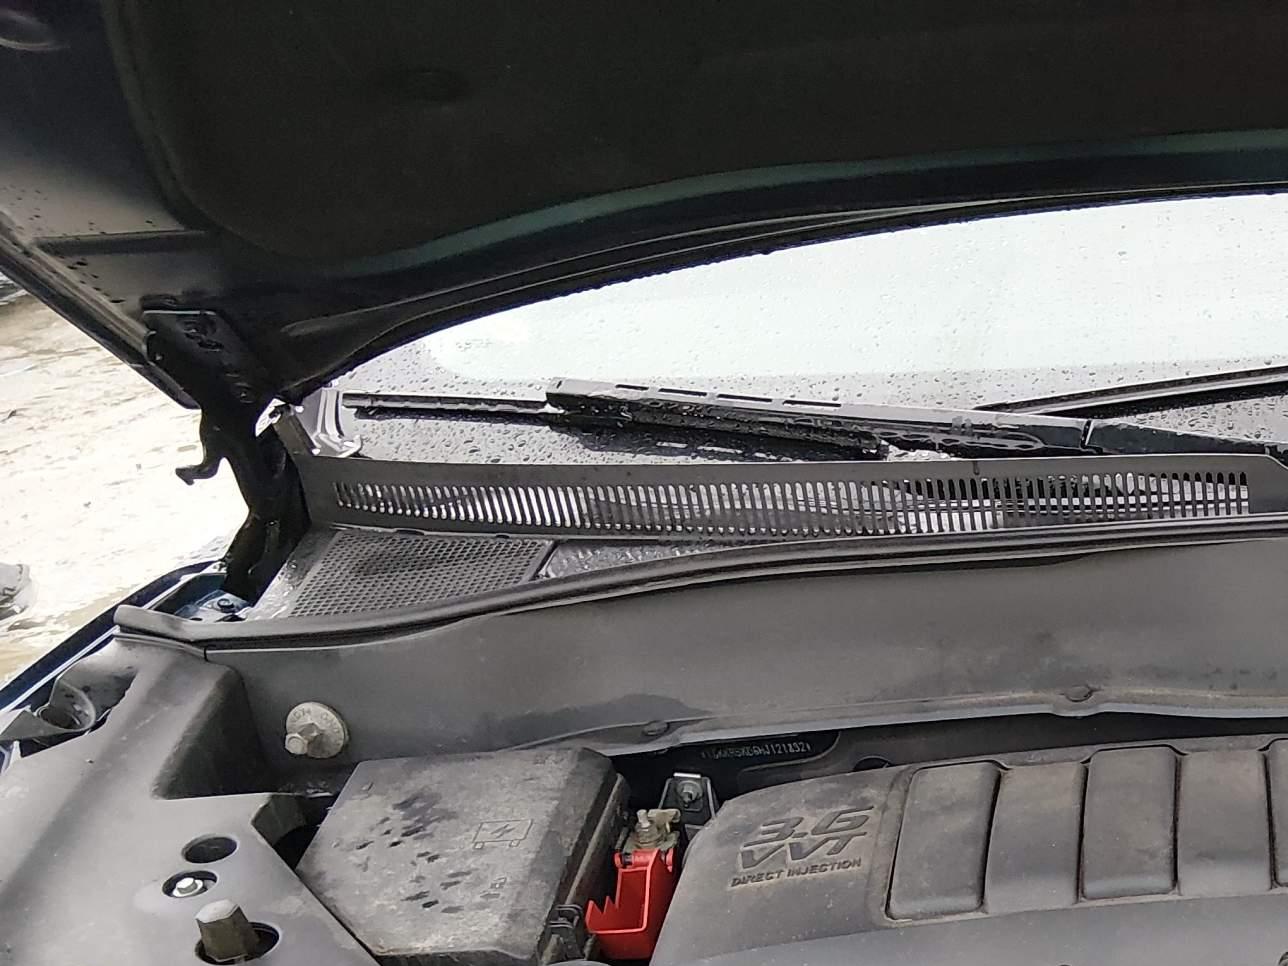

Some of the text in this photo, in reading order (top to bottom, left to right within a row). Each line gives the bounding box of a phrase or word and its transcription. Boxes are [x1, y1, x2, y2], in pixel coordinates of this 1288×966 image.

[744, 806, 875, 848] 3.6
[740, 831, 867, 869] VVT
[731, 857, 862, 887] DIRECT INJECTION
